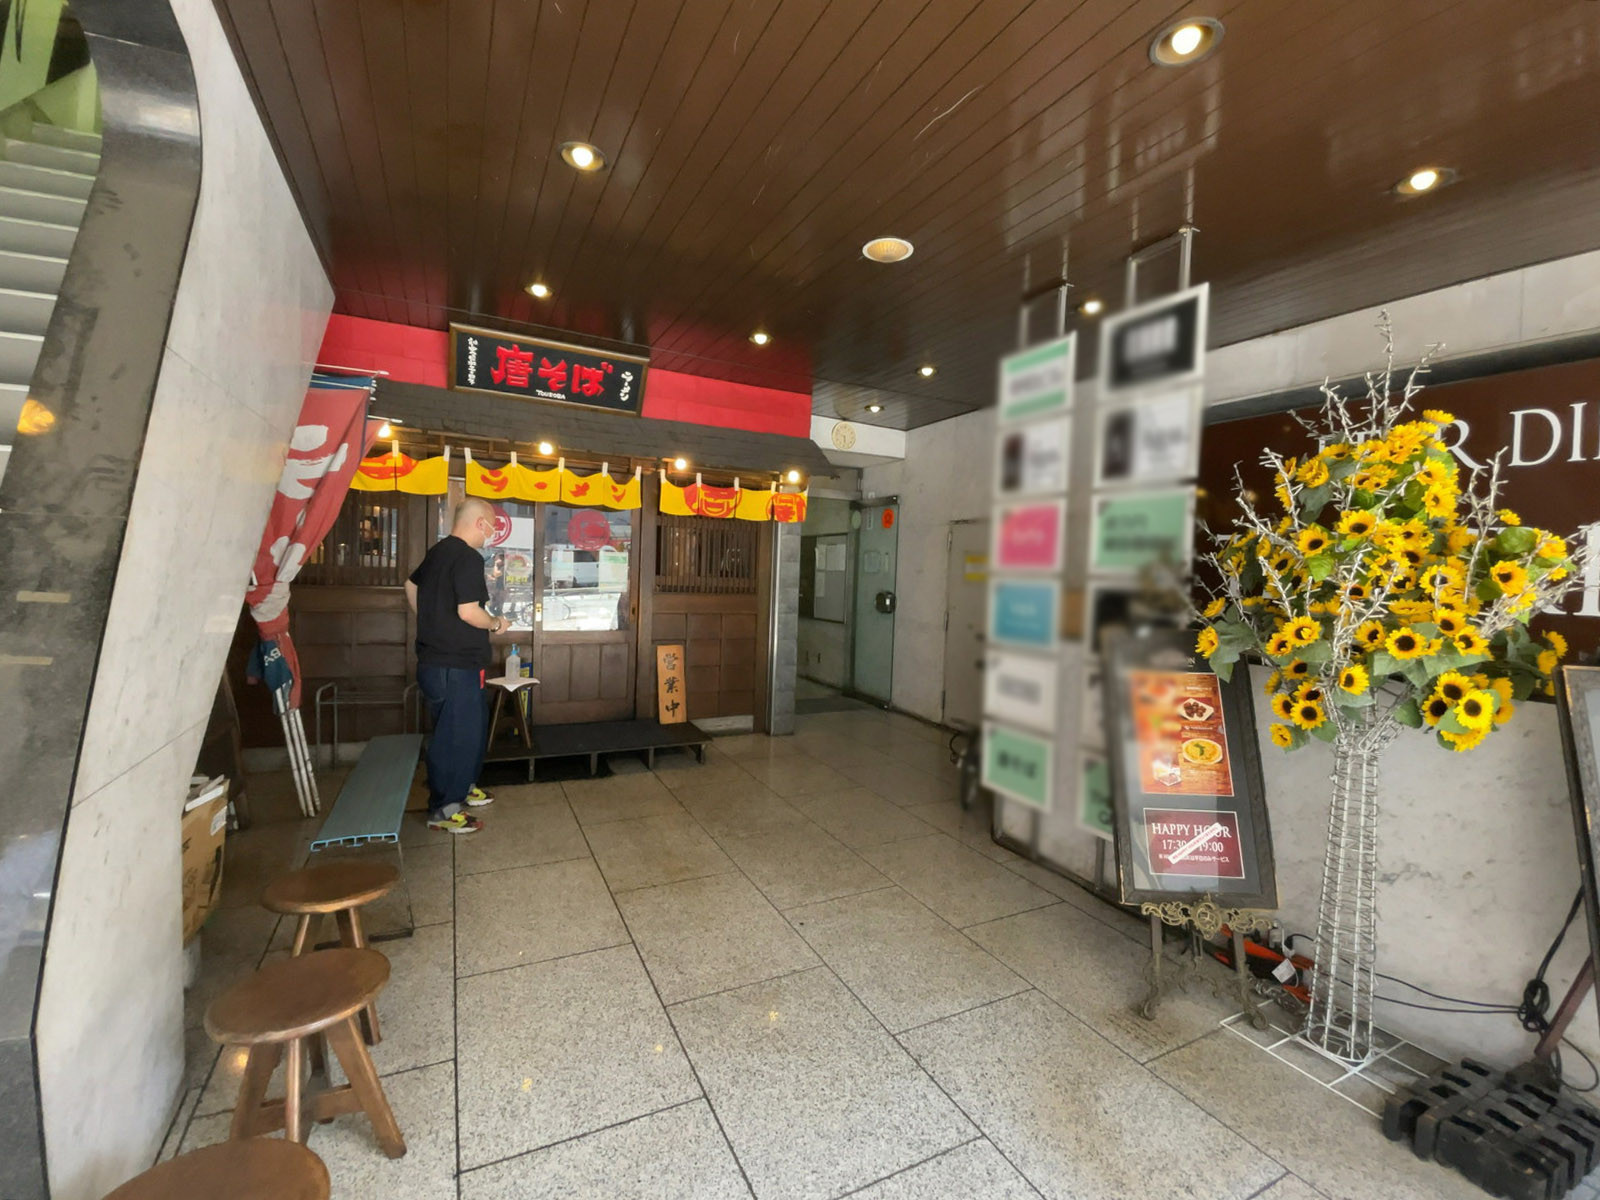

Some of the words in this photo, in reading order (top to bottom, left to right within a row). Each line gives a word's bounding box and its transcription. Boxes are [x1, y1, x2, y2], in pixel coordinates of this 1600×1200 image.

[490, 344, 613, 397] 唐そば
[1508, 402, 1600, 467] DI
[663, 653, 680, 718] 営業中
[1152, 823, 1190, 836] HAPPY
